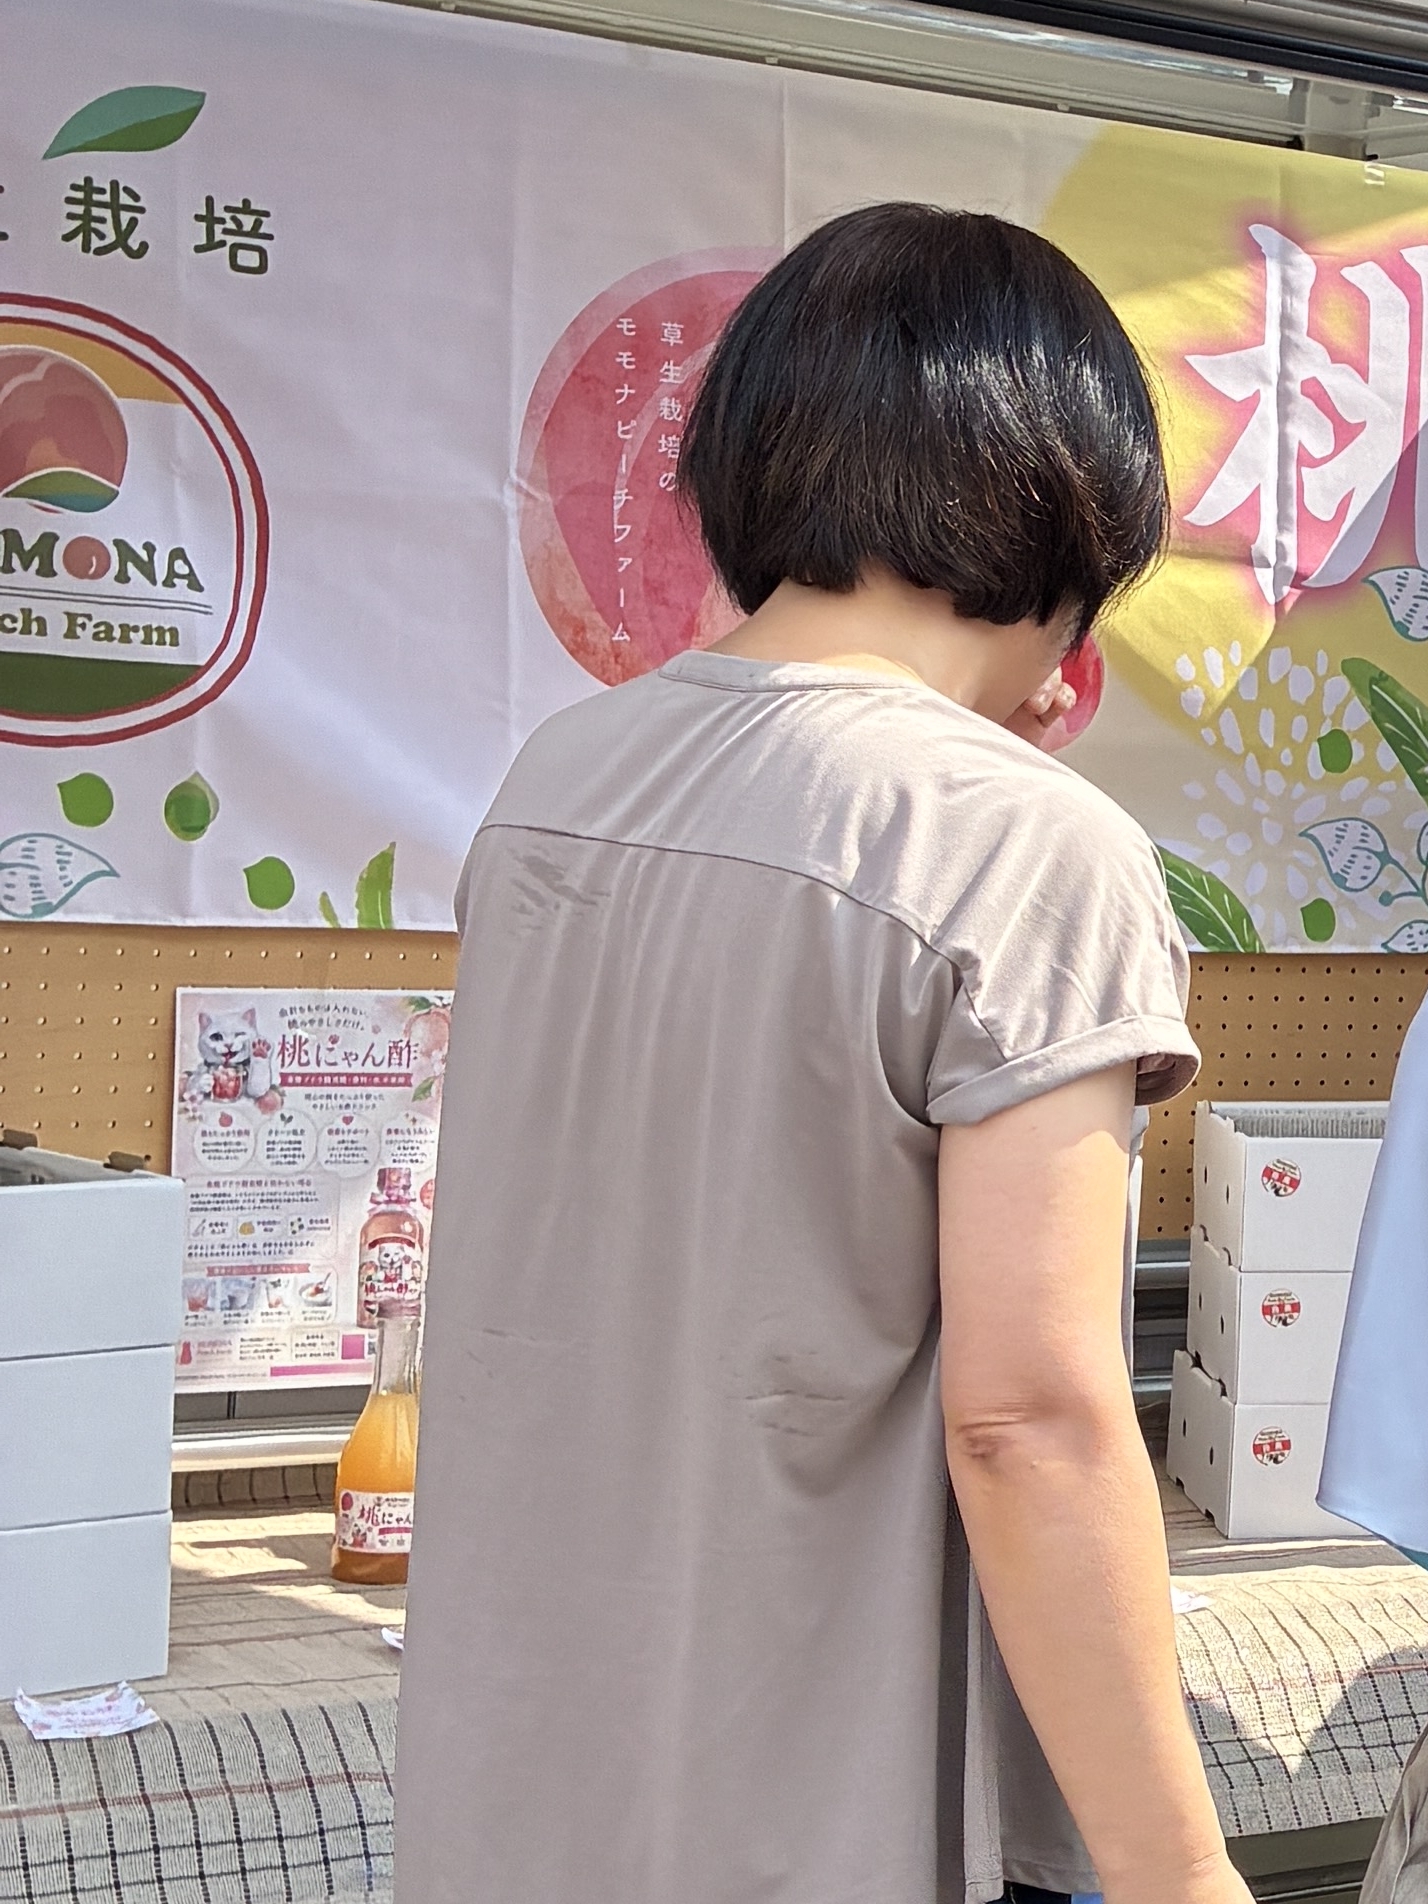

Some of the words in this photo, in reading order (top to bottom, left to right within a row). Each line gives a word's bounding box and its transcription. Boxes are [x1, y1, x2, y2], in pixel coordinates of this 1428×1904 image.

[0, 174, 275, 277] 栽培
[659, 322, 686, 494] 草生栽培の
[611, 315, 639, 645] モモナピーチファーム
[63, 610, 181, 647] Farm
[276, 1033, 420, 1069] 桃にゃん酢
